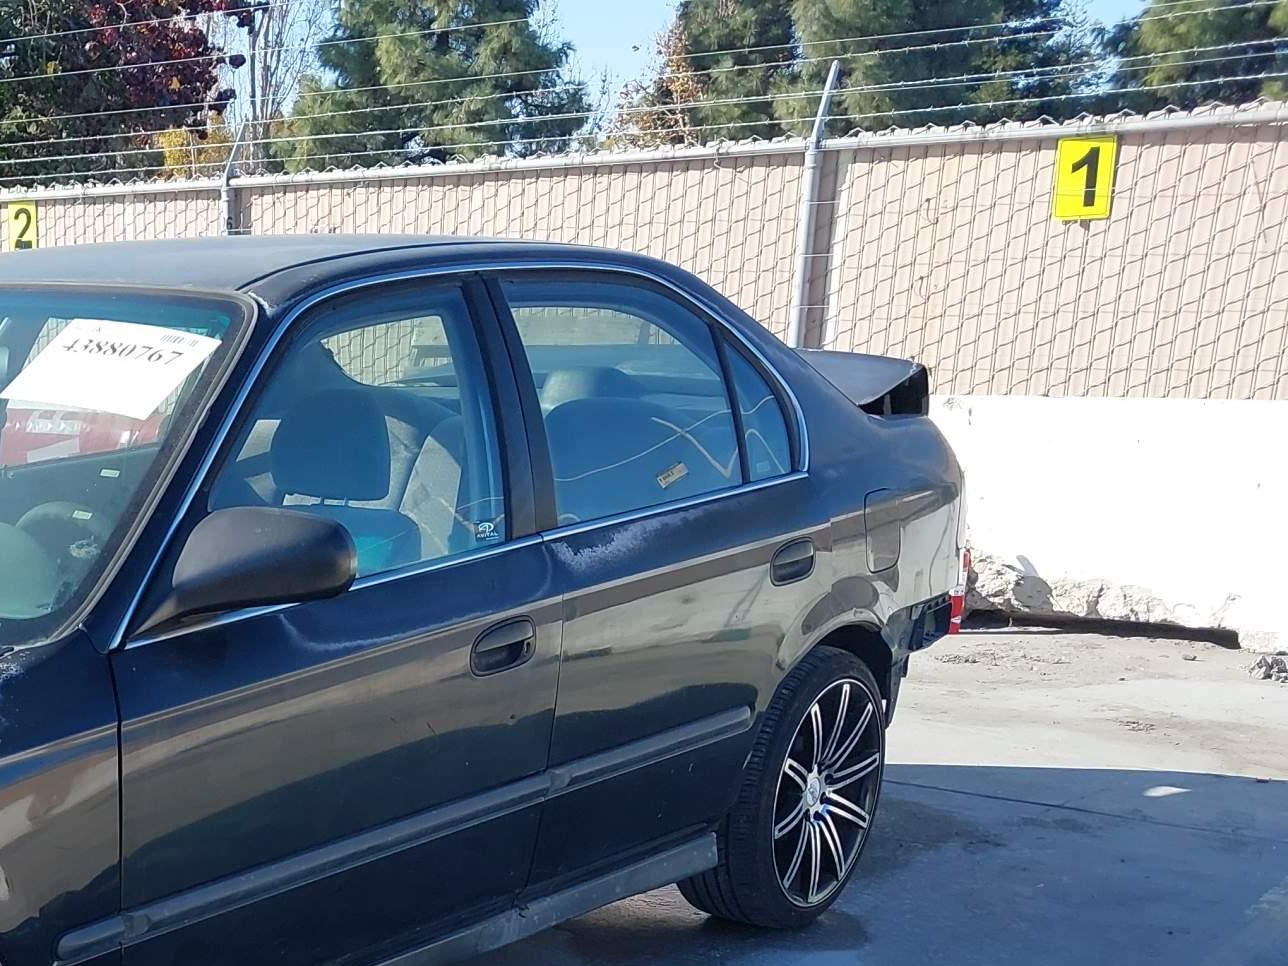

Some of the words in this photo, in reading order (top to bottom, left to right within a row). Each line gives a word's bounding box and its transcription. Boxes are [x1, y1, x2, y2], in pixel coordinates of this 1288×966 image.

[1071, 146, 1101, 207] 1
[13, 207, 33, 250] 2
[62, 336, 185, 366] 43880767
